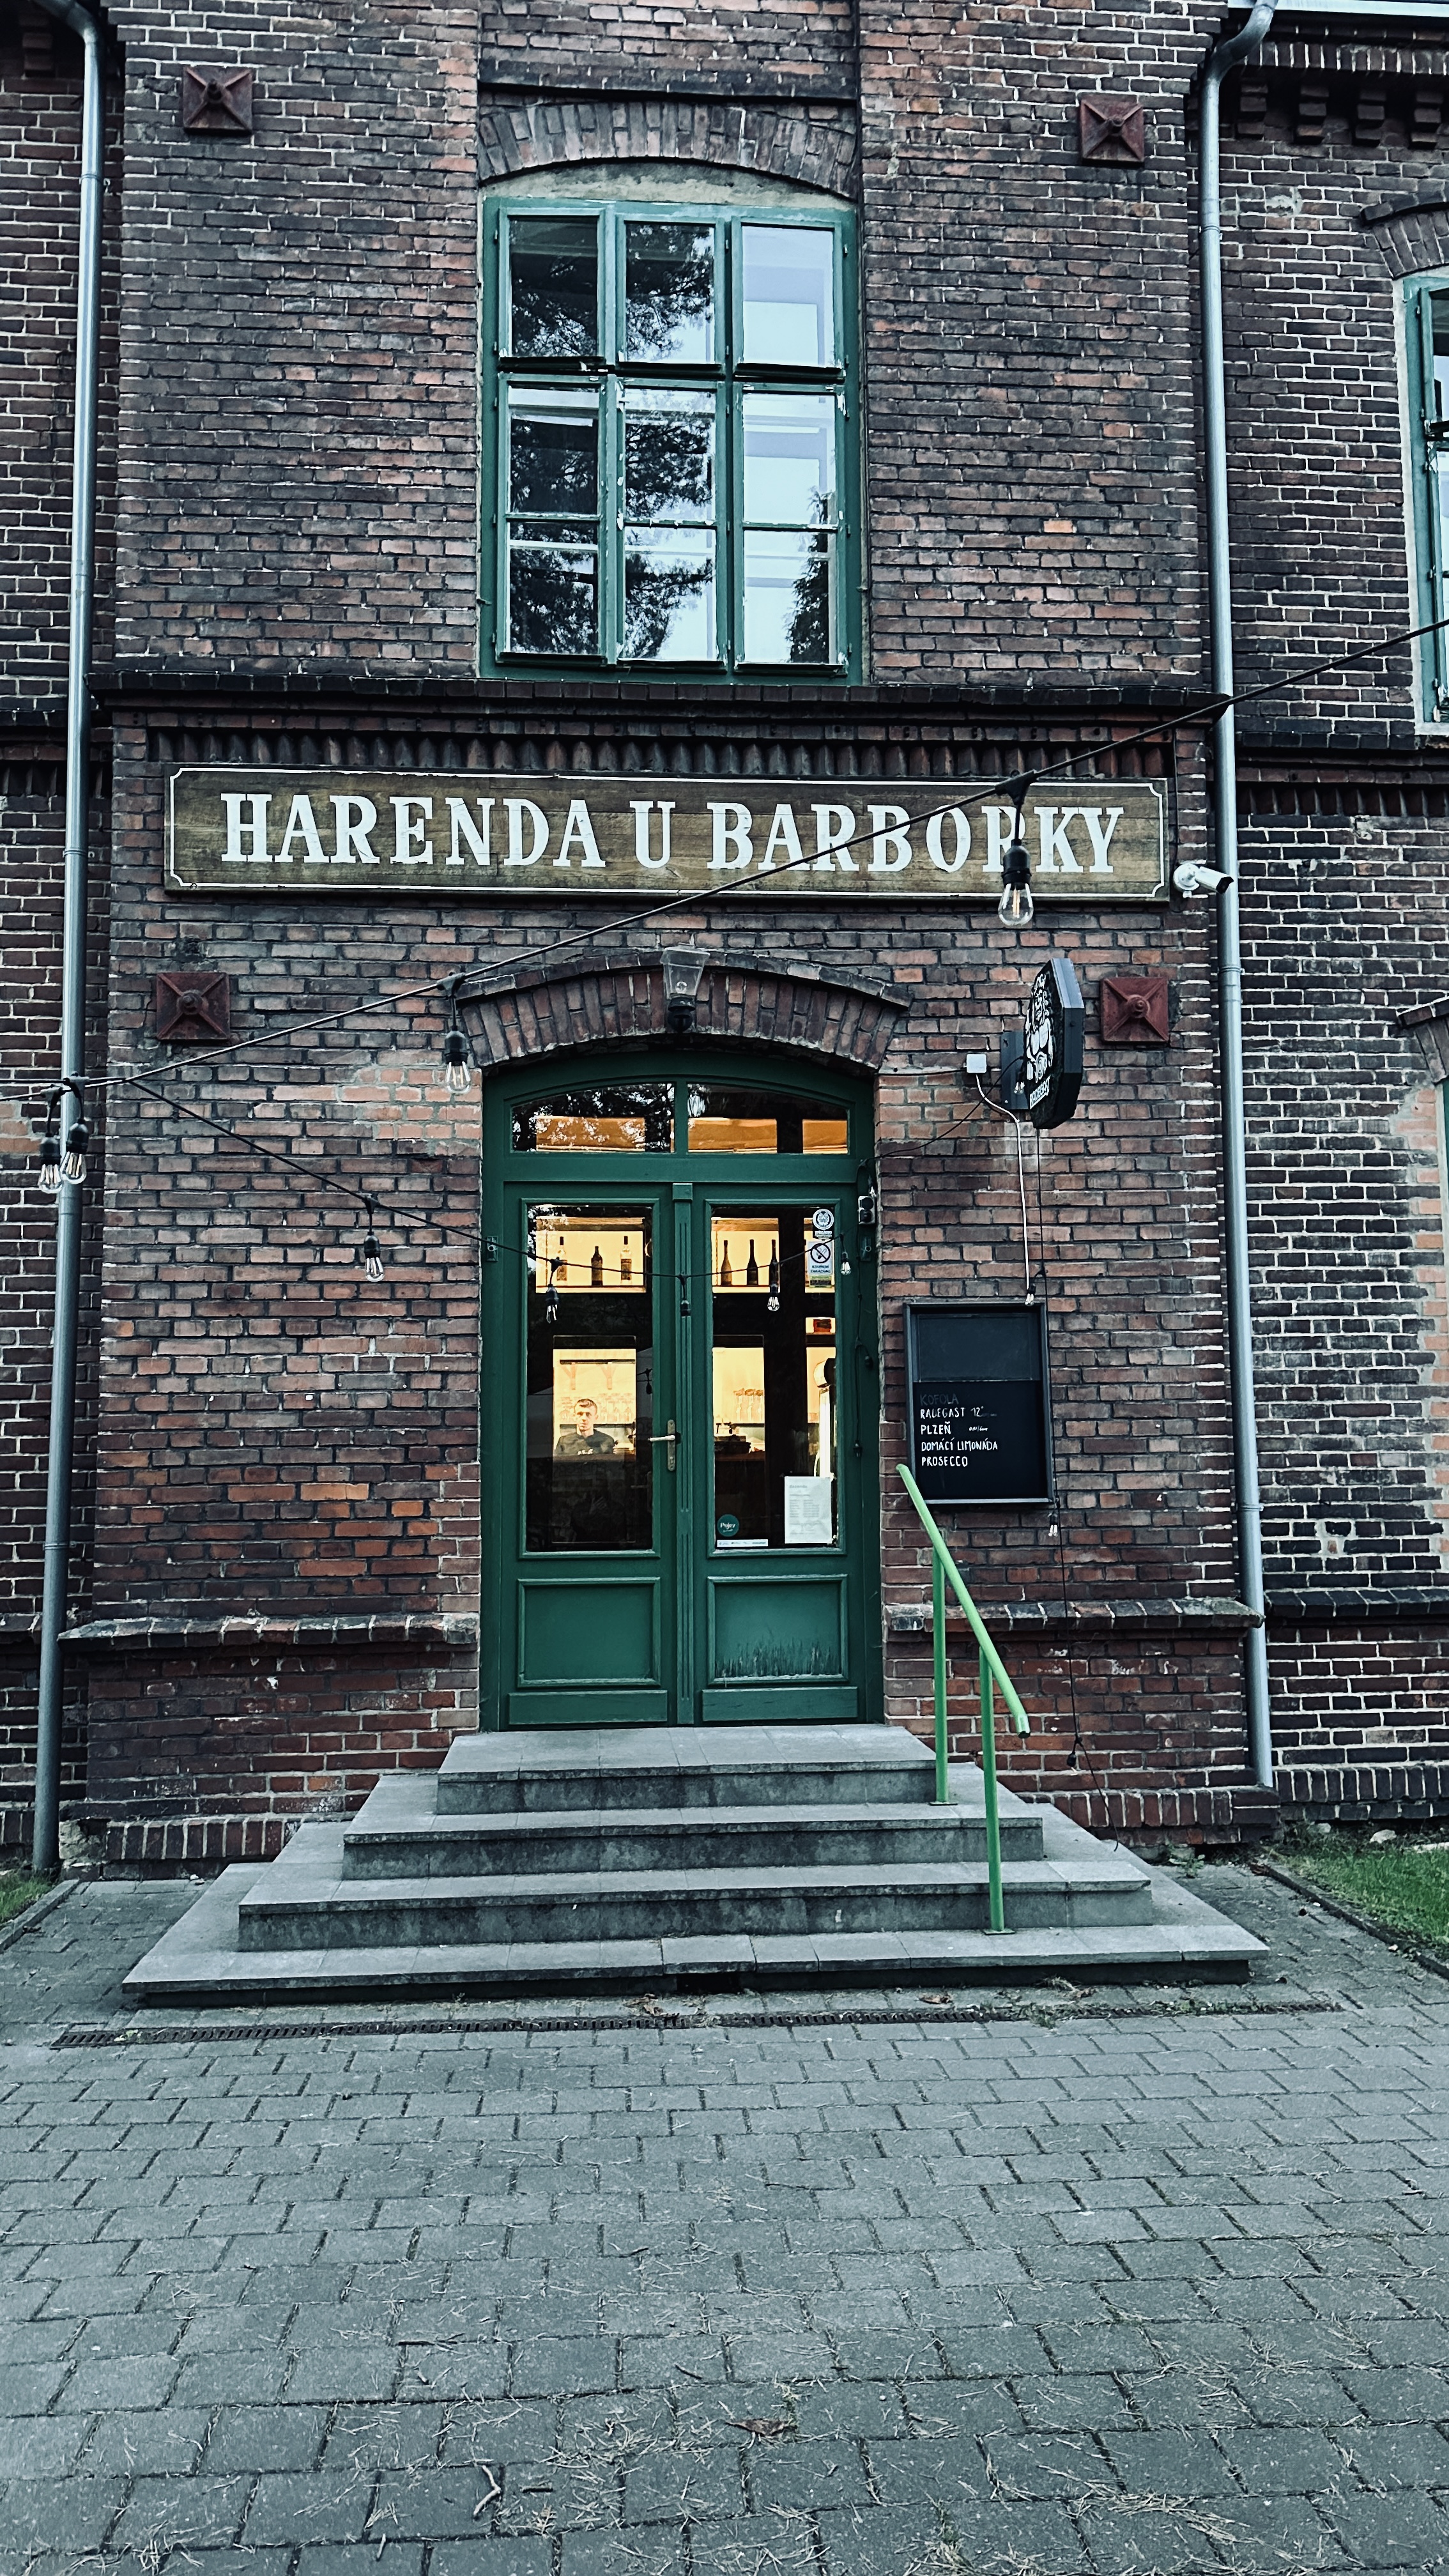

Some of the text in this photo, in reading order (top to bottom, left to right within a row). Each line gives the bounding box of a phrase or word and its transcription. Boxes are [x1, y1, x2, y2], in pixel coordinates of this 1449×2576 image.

[220, 792, 1124, 873] HARENDA U BARBORKY
[920, 1421, 951, 1436] PLZEŇ
[921, 1438, 999, 1452] DOMÁCÍ LIMONÁDA
[921, 1455, 969, 1468] PROSECCO
